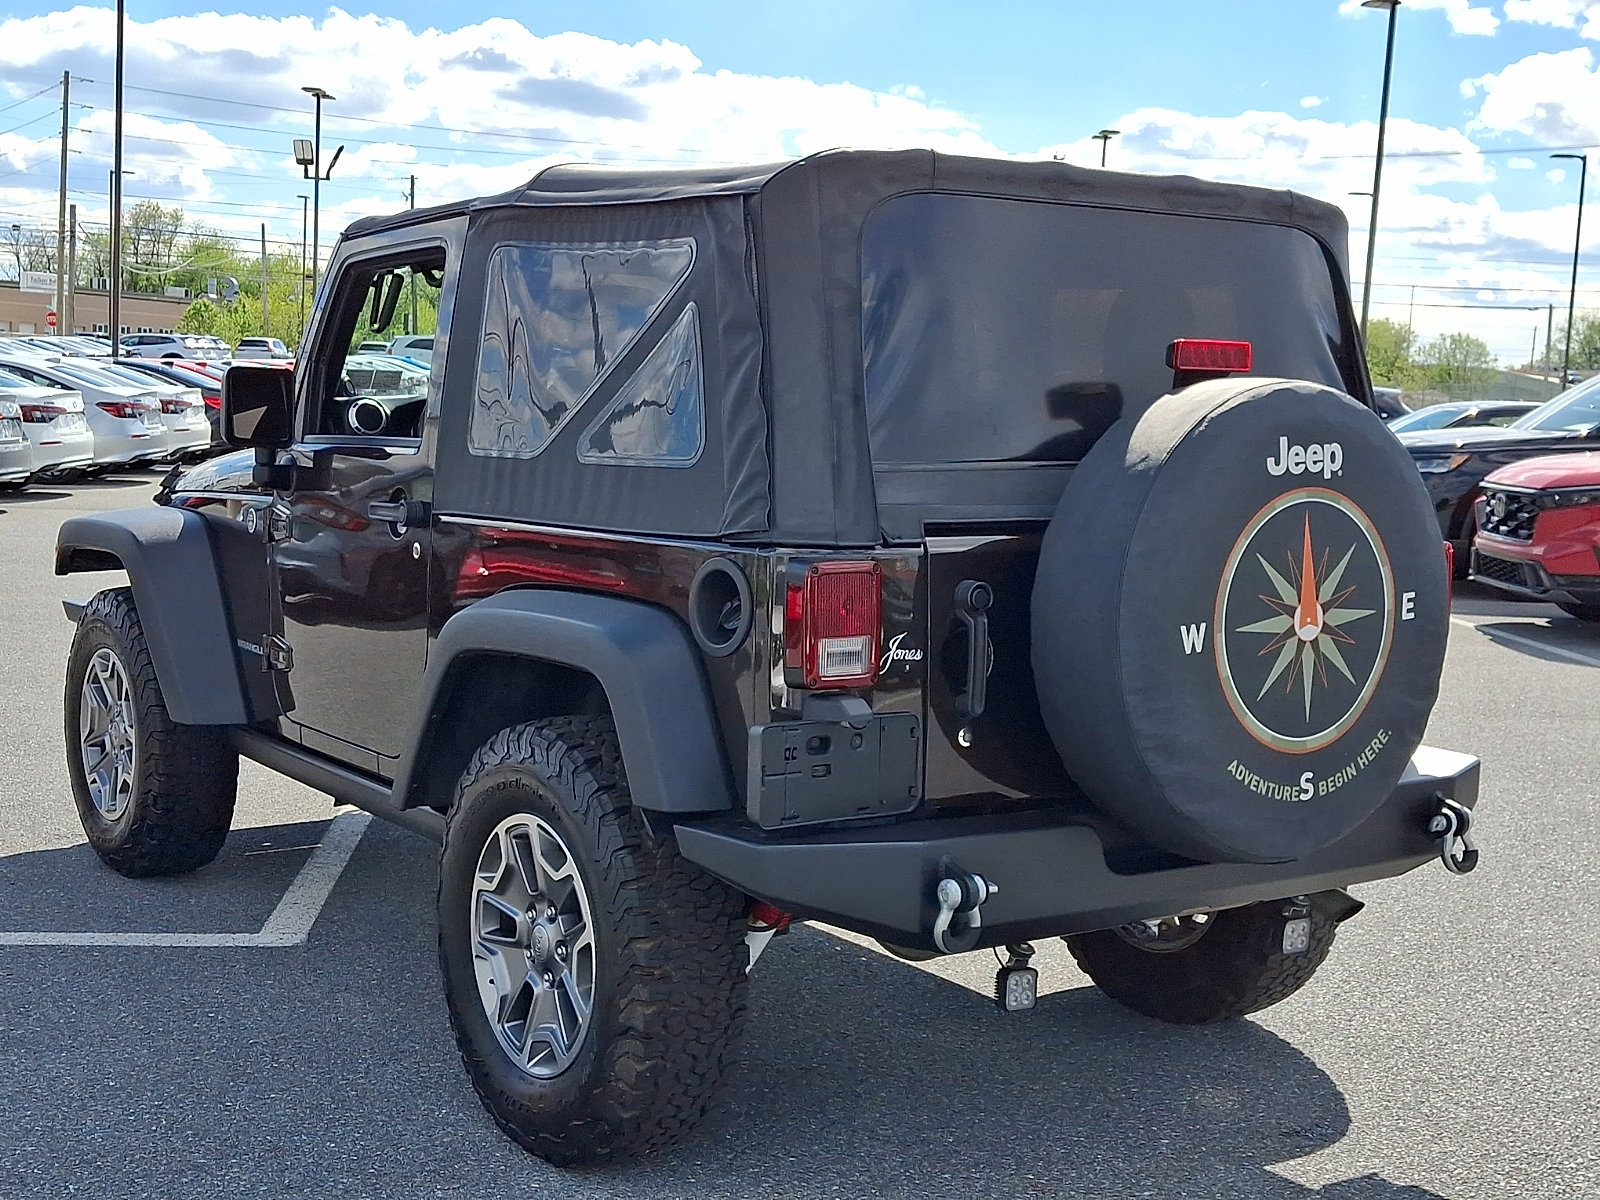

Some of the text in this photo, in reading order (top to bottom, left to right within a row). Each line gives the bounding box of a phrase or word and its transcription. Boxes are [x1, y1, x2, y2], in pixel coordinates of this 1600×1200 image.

[46, 315, 57, 323] STO
[1266, 436, 1343, 479] Jeep
[1401, 591, 1416, 621] E
[879, 631, 923, 675] Jones
[1180, 622, 1207, 655] W
[1318, 766, 1357, 797] BEGIN
[1357, 727, 1392, 770] HERE.
